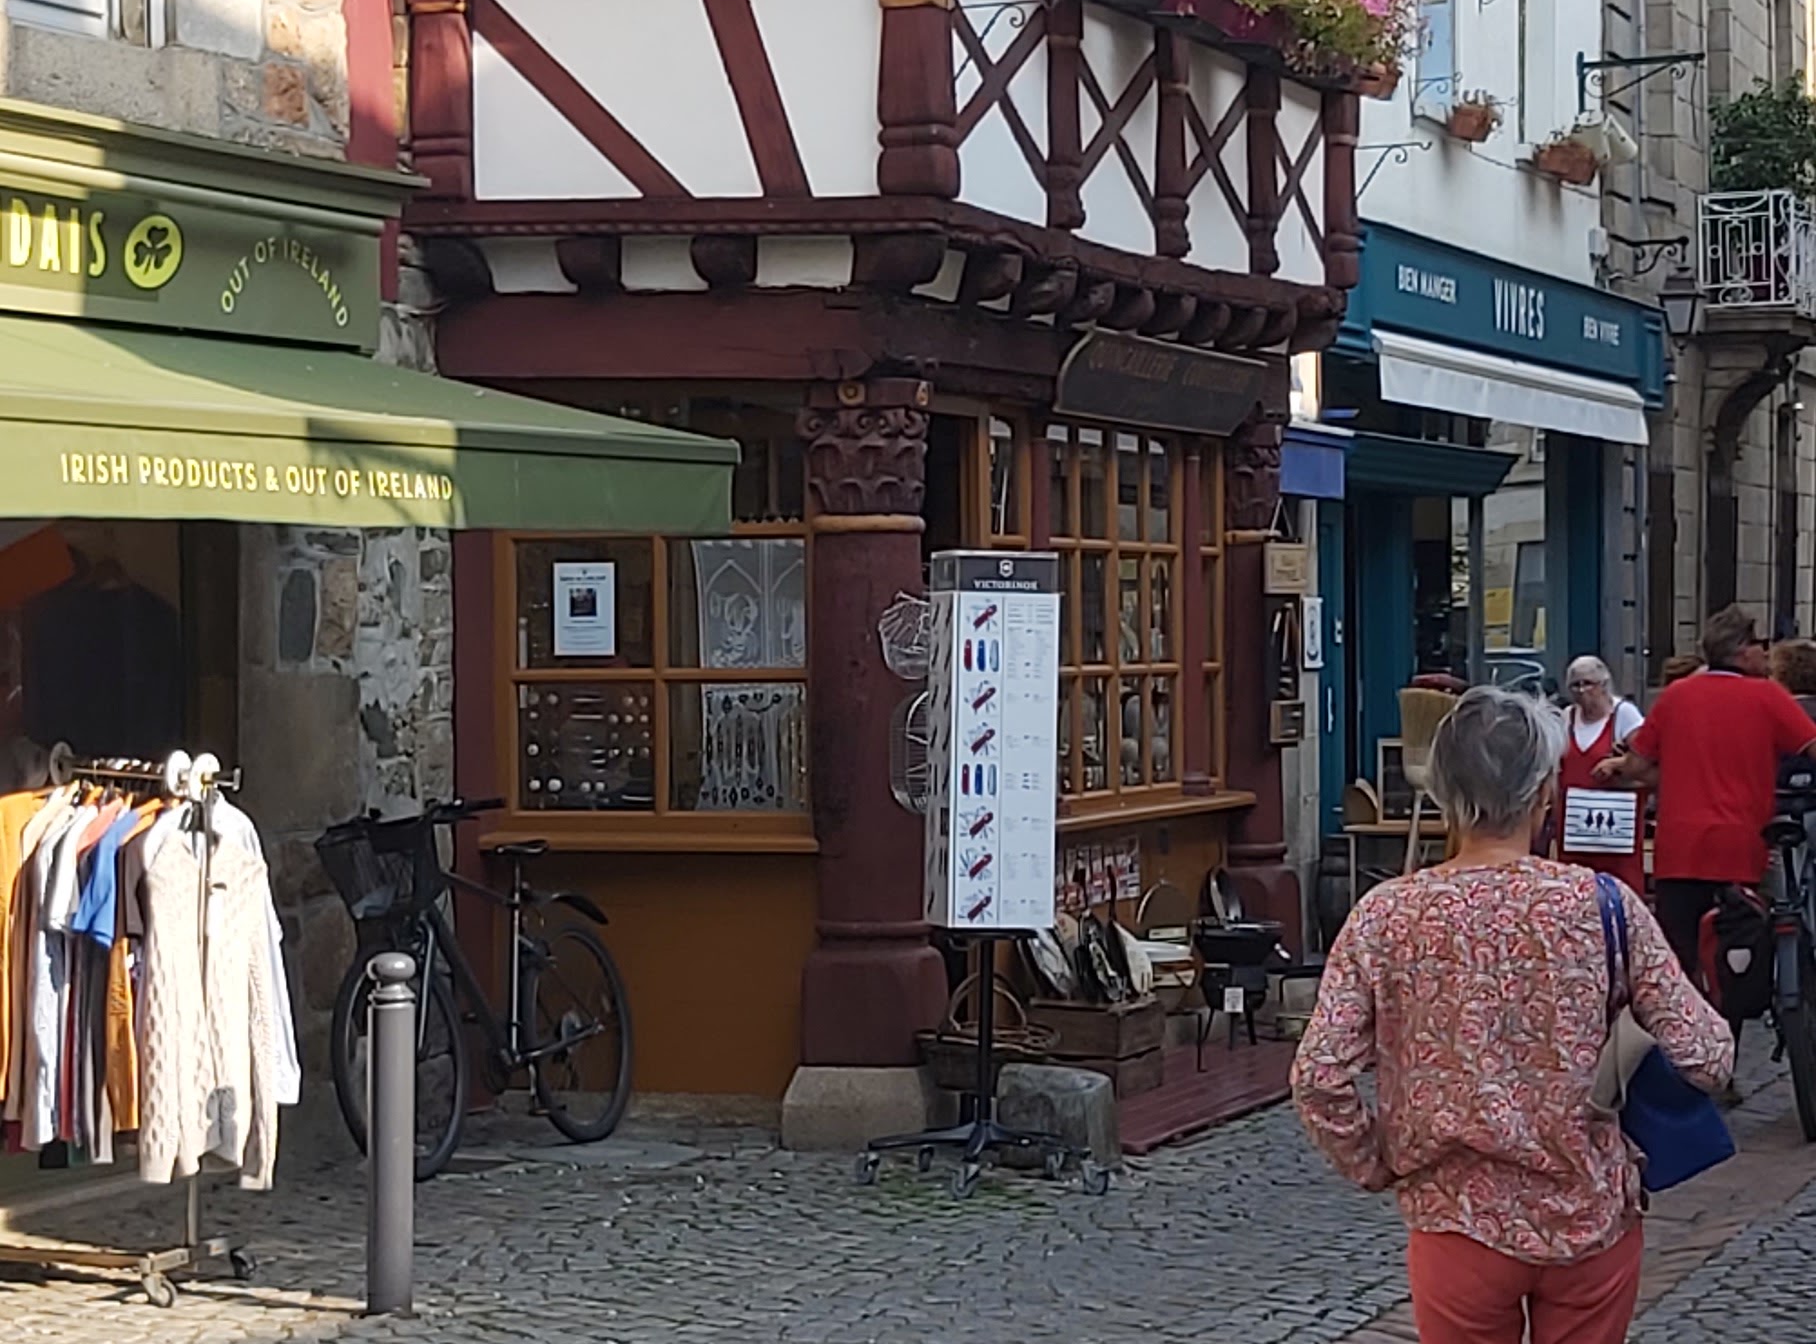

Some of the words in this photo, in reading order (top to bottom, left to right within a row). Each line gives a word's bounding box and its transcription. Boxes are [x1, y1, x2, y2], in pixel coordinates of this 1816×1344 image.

[9, 197, 107, 278] DAIS
[221, 256, 250, 313] OUT
[255, 237, 276, 264] OF
[283, 238, 348, 327] IRELAND
[1493, 277, 1545, 340] VIVRES
[60, 452, 130, 484] IRISH
[138, 456, 258, 492] PRODUCTS
[265, 465, 280, 492] &
[286, 465, 327, 495] OUT
[334, 469, 361, 497] OF
[368, 470, 453, 501] IRELAND
